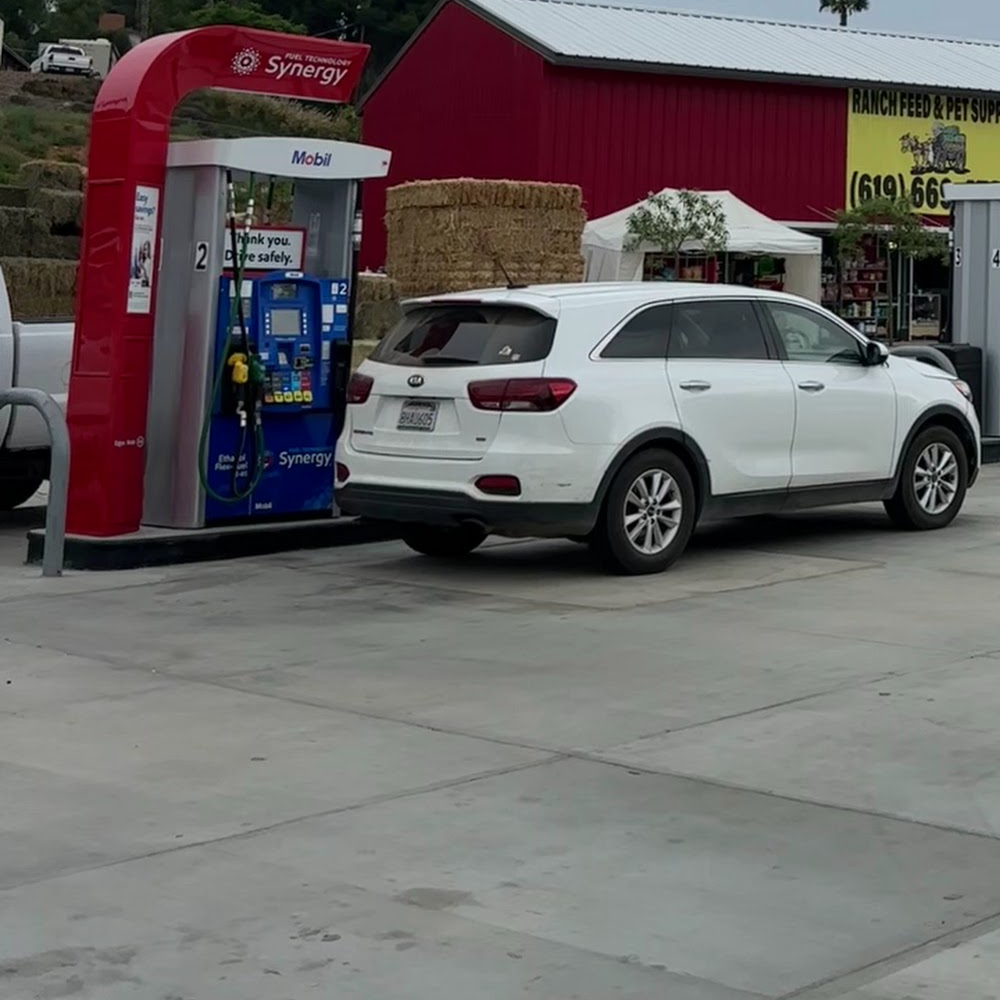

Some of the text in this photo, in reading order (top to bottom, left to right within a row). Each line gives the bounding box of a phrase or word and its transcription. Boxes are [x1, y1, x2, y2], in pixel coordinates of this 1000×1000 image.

[285, 52, 302, 61] FUEL
[265, 56, 348, 86] Synergy
[852, 88, 897, 117] RANCH
[900, 92, 931, 119] FEED
[933, 96, 944, 120] &
[946, 97, 969, 122] PET
[291, 150, 332, 167] Mobil
[267, 236, 291, 248] you.
[195, 242, 208, 270] 2
[258, 250, 293, 266] safely.
[955, 247, 961, 266] 3
[992, 249, 1000, 267] 4
[340, 283, 347, 295] 2
[218, 453, 246, 463] Ethaol
[279, 451, 332, 469] Synergy
